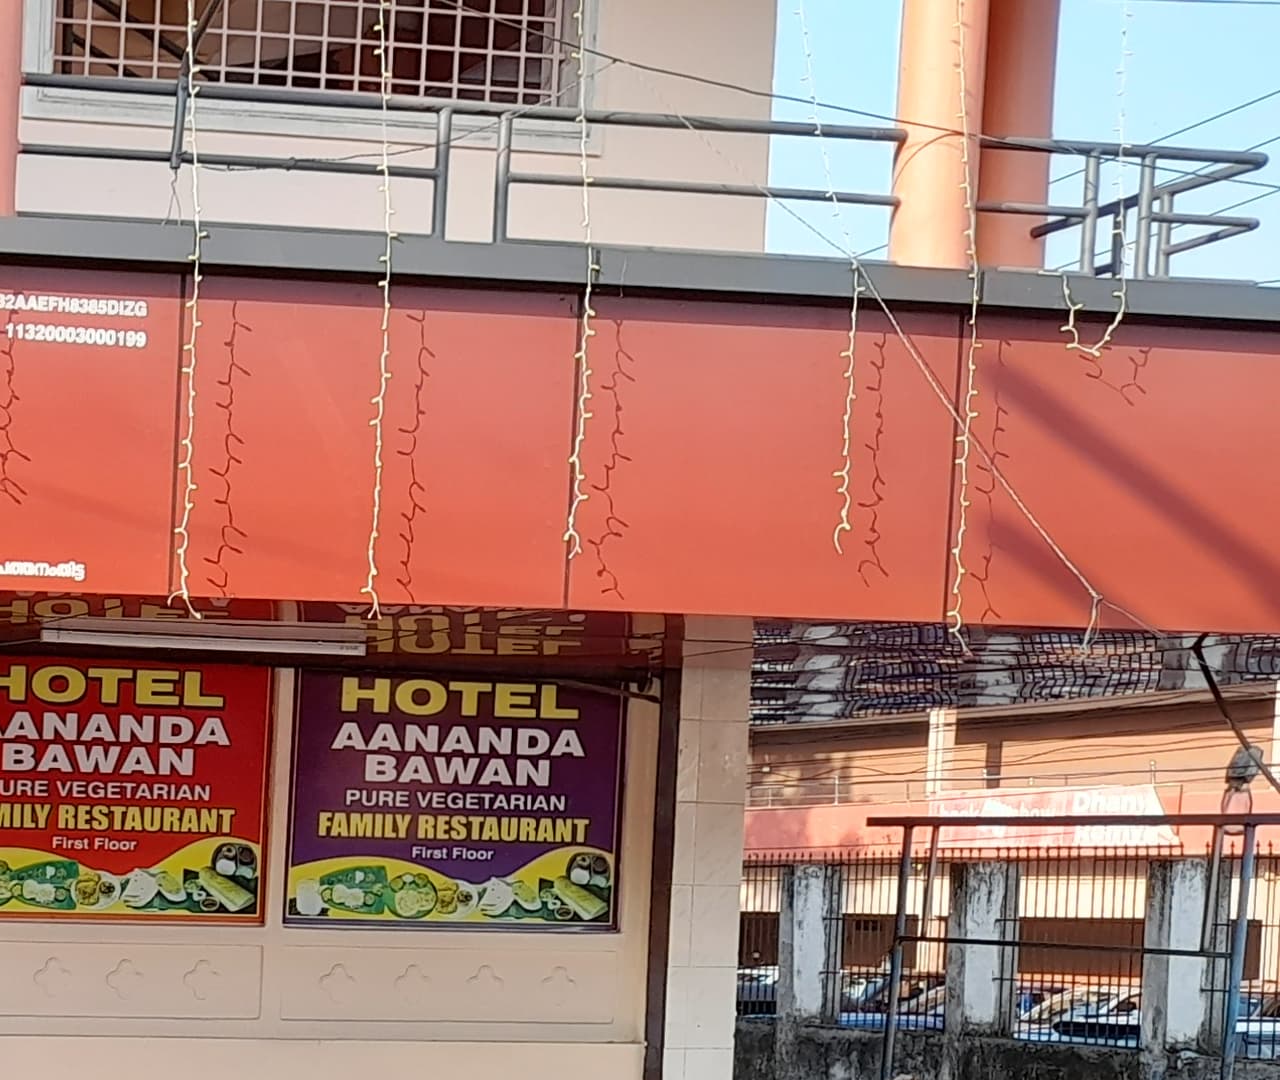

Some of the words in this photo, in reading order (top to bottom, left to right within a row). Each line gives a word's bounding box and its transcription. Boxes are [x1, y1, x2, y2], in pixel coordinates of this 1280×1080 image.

[340, 676, 580, 720] HOTEL
[330, 722, 586, 757] AANANDA
[1, 743, 195, 776] BAWAN
[364, 754, 551, 787] BAWAN
[56, 780, 211, 802] VEGETARIAN
[345, 789, 410, 807] PURE
[416, 791, 566, 811] VEGETARIAN
[57, 804, 235, 834] RESTAURANT
[317, 811, 412, 839] FAMILY
[416, 815, 590, 844] RESTAURANT
[52, 836, 89, 850] First
[94, 836, 137, 851] Floor
[411, 846, 448, 859] First
[452, 847, 494, 861] Floor
